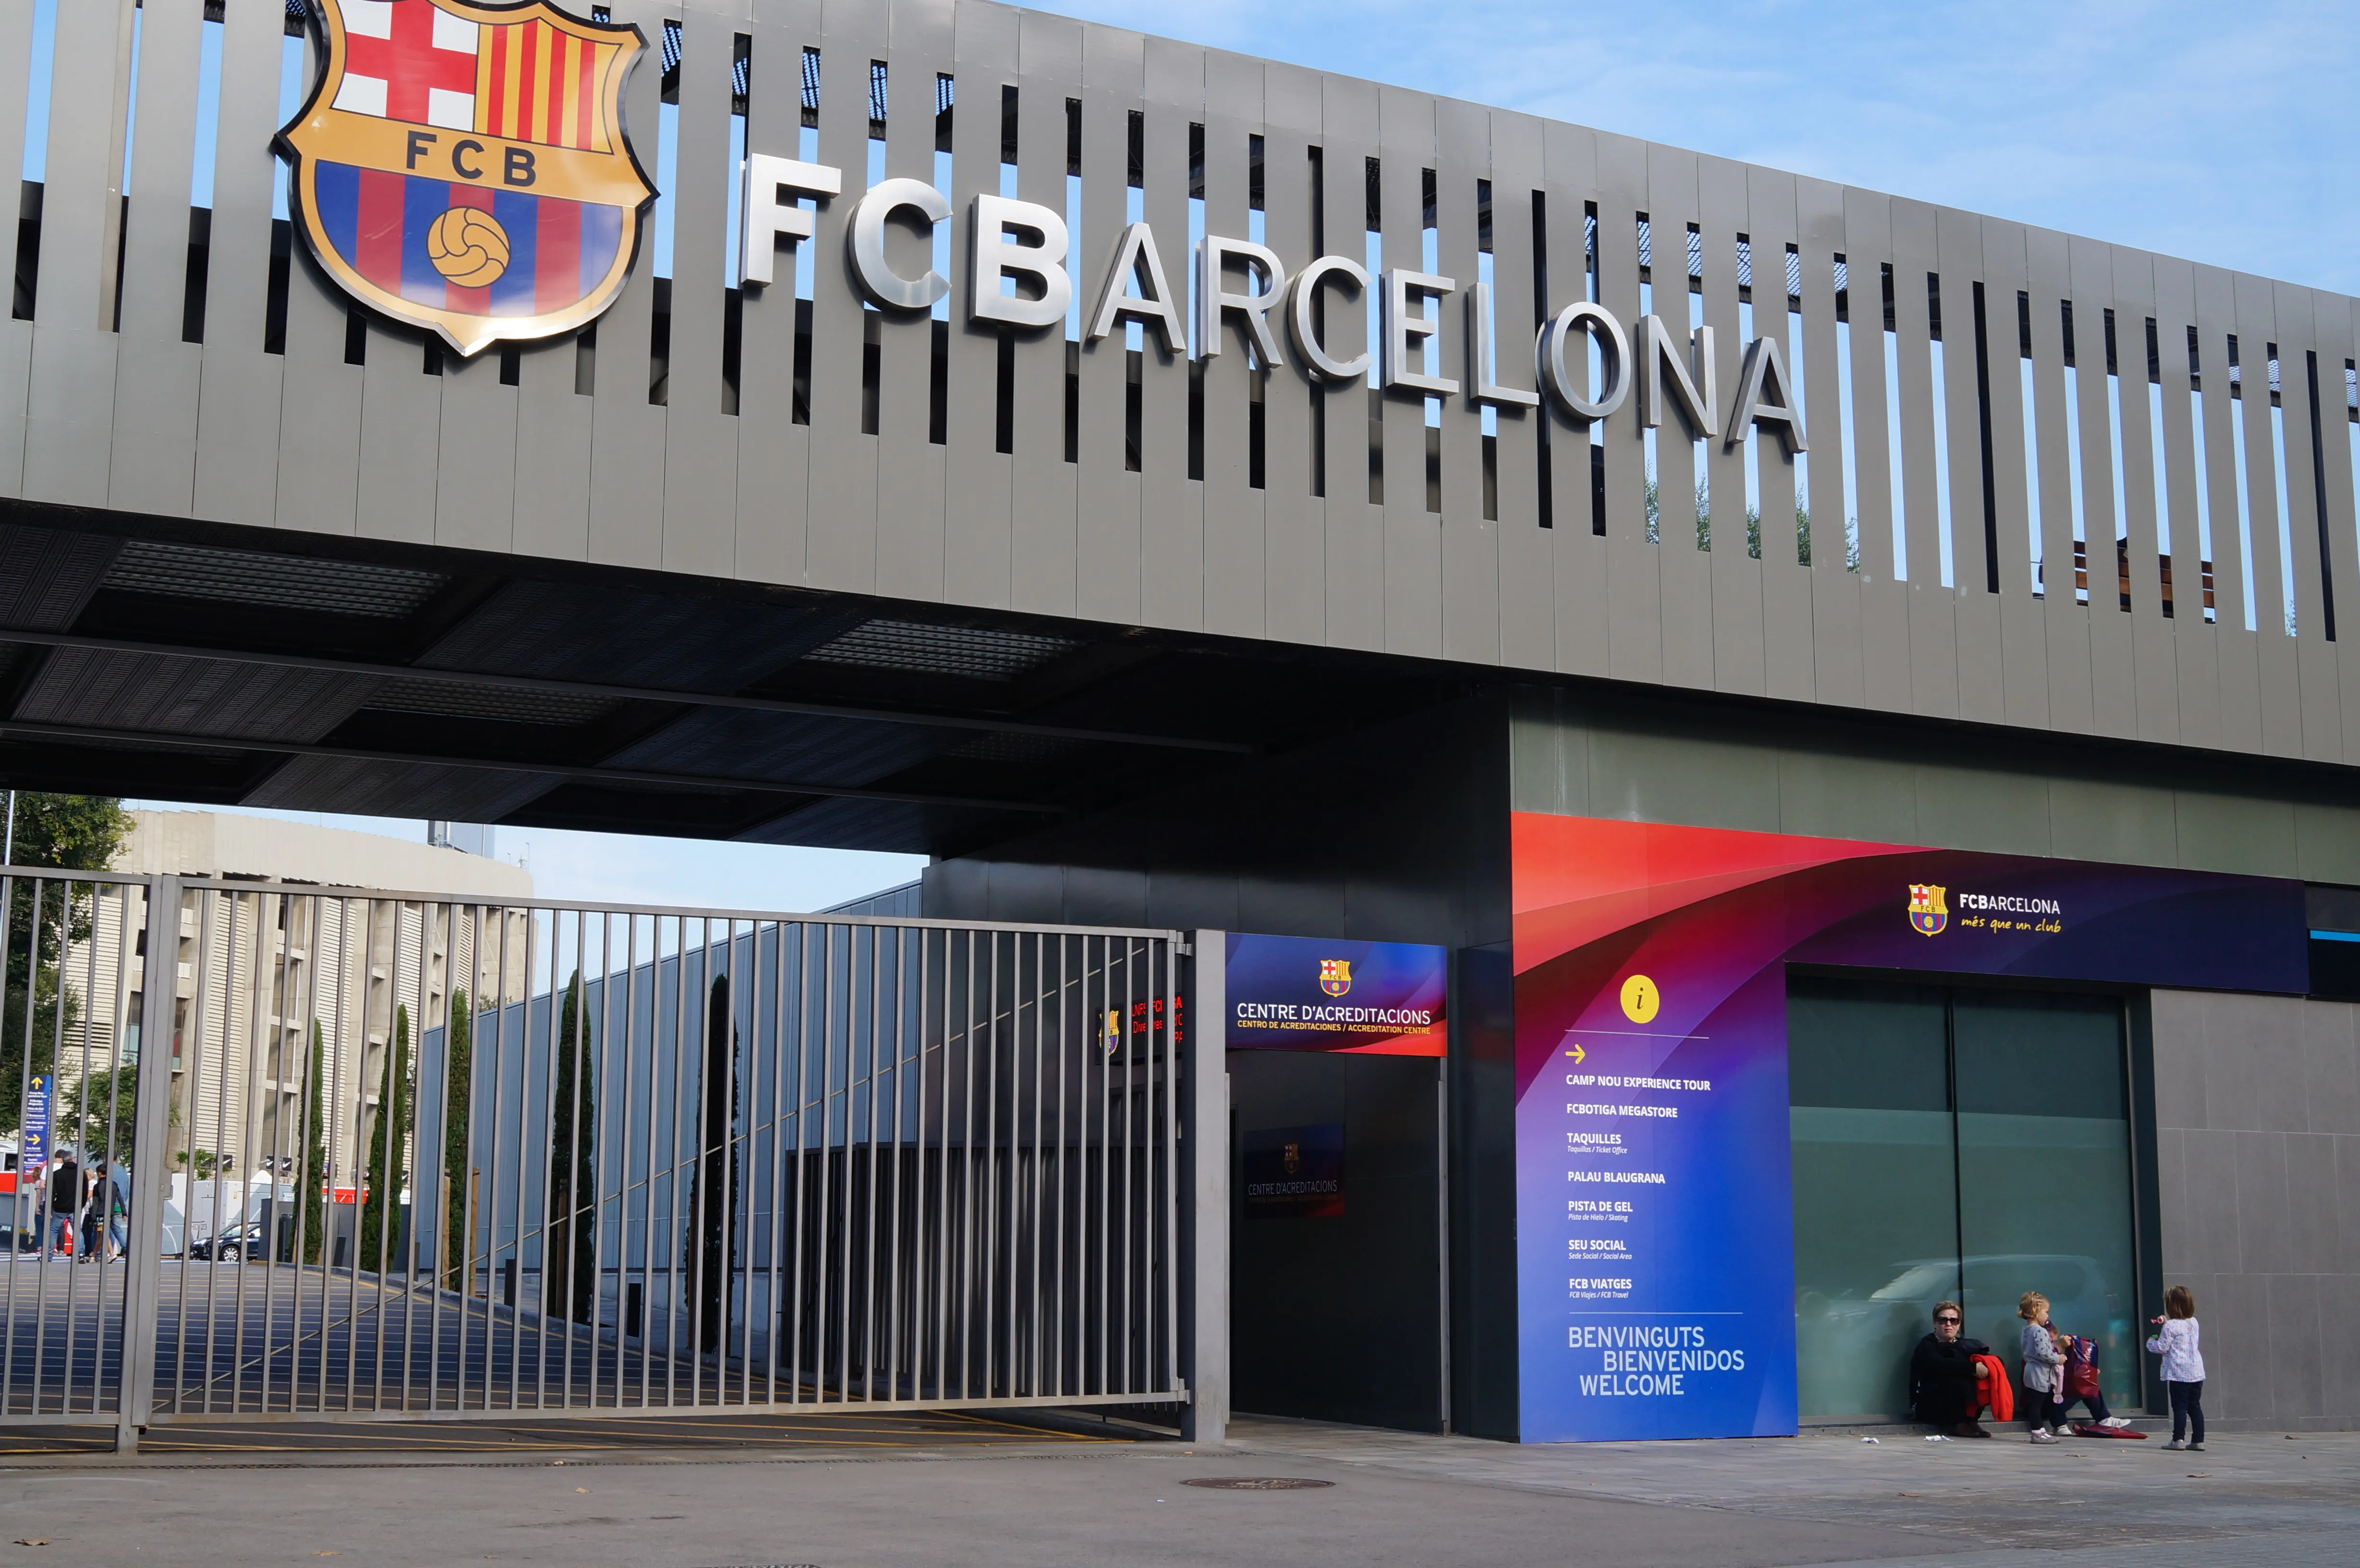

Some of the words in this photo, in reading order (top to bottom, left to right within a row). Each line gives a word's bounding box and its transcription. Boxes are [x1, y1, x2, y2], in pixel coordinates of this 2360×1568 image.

[406, 131, 536, 187] FCB
[1960, 894, 2060, 914] FCBARCELONA
[1961, 916, 1985, 927] més
[1990, 919, 2012, 933] que
[2035, 918, 2061, 933] club
[1237, 1003, 1297, 1019] CENTRE
[1303, 1005, 1430, 1024] D'ACREDITACIONS
[1280, 1022, 1341, 1031] ACREDITACIONES
[1348, 1025, 1402, 1033] ACCREDITATION
[1566, 1075, 1595, 1085] CAMP
[1598, 1076, 1621, 1087] NOU
[1623, 1077, 1681, 1090] EXPERIENCE
[1683, 1080, 1711, 1090] TOUR
[1567, 1103, 1617, 1115] FCBOTIGA
[1619, 1105, 1678, 1118] MEGASTORE
[1567, 1133, 1621, 1145] TAQUILLES
[1612, 1147, 1627, 1155] Office
[1568, 1171, 1601, 1182] PALAU
[1604, 1172, 1665, 1184] BLAUGRANA
[1248, 1183, 1274, 1195] CENTRE
[1277, 1180, 1337, 1194] D'ACREDITACIONS
[1568, 1201, 1597, 1211] PISTA
[1599, 1201, 1612, 1212] DE
[1614, 1202, 1633, 1212] GEL
[1569, 1239, 1587, 1250] SEU
[1590, 1240, 1626, 1250] SOCIAL
[1569, 1278, 1588, 1289] FCB
[1590, 1278, 1632, 1289] VIATGES
[1581, 1291, 1596, 1299] Viajes
[1569, 1326, 1705, 1348] BENVINGUTS
[1604, 1350, 1745, 1372] BIENVENIDOS
[1580, 1374, 1684, 1396] WELCOME
